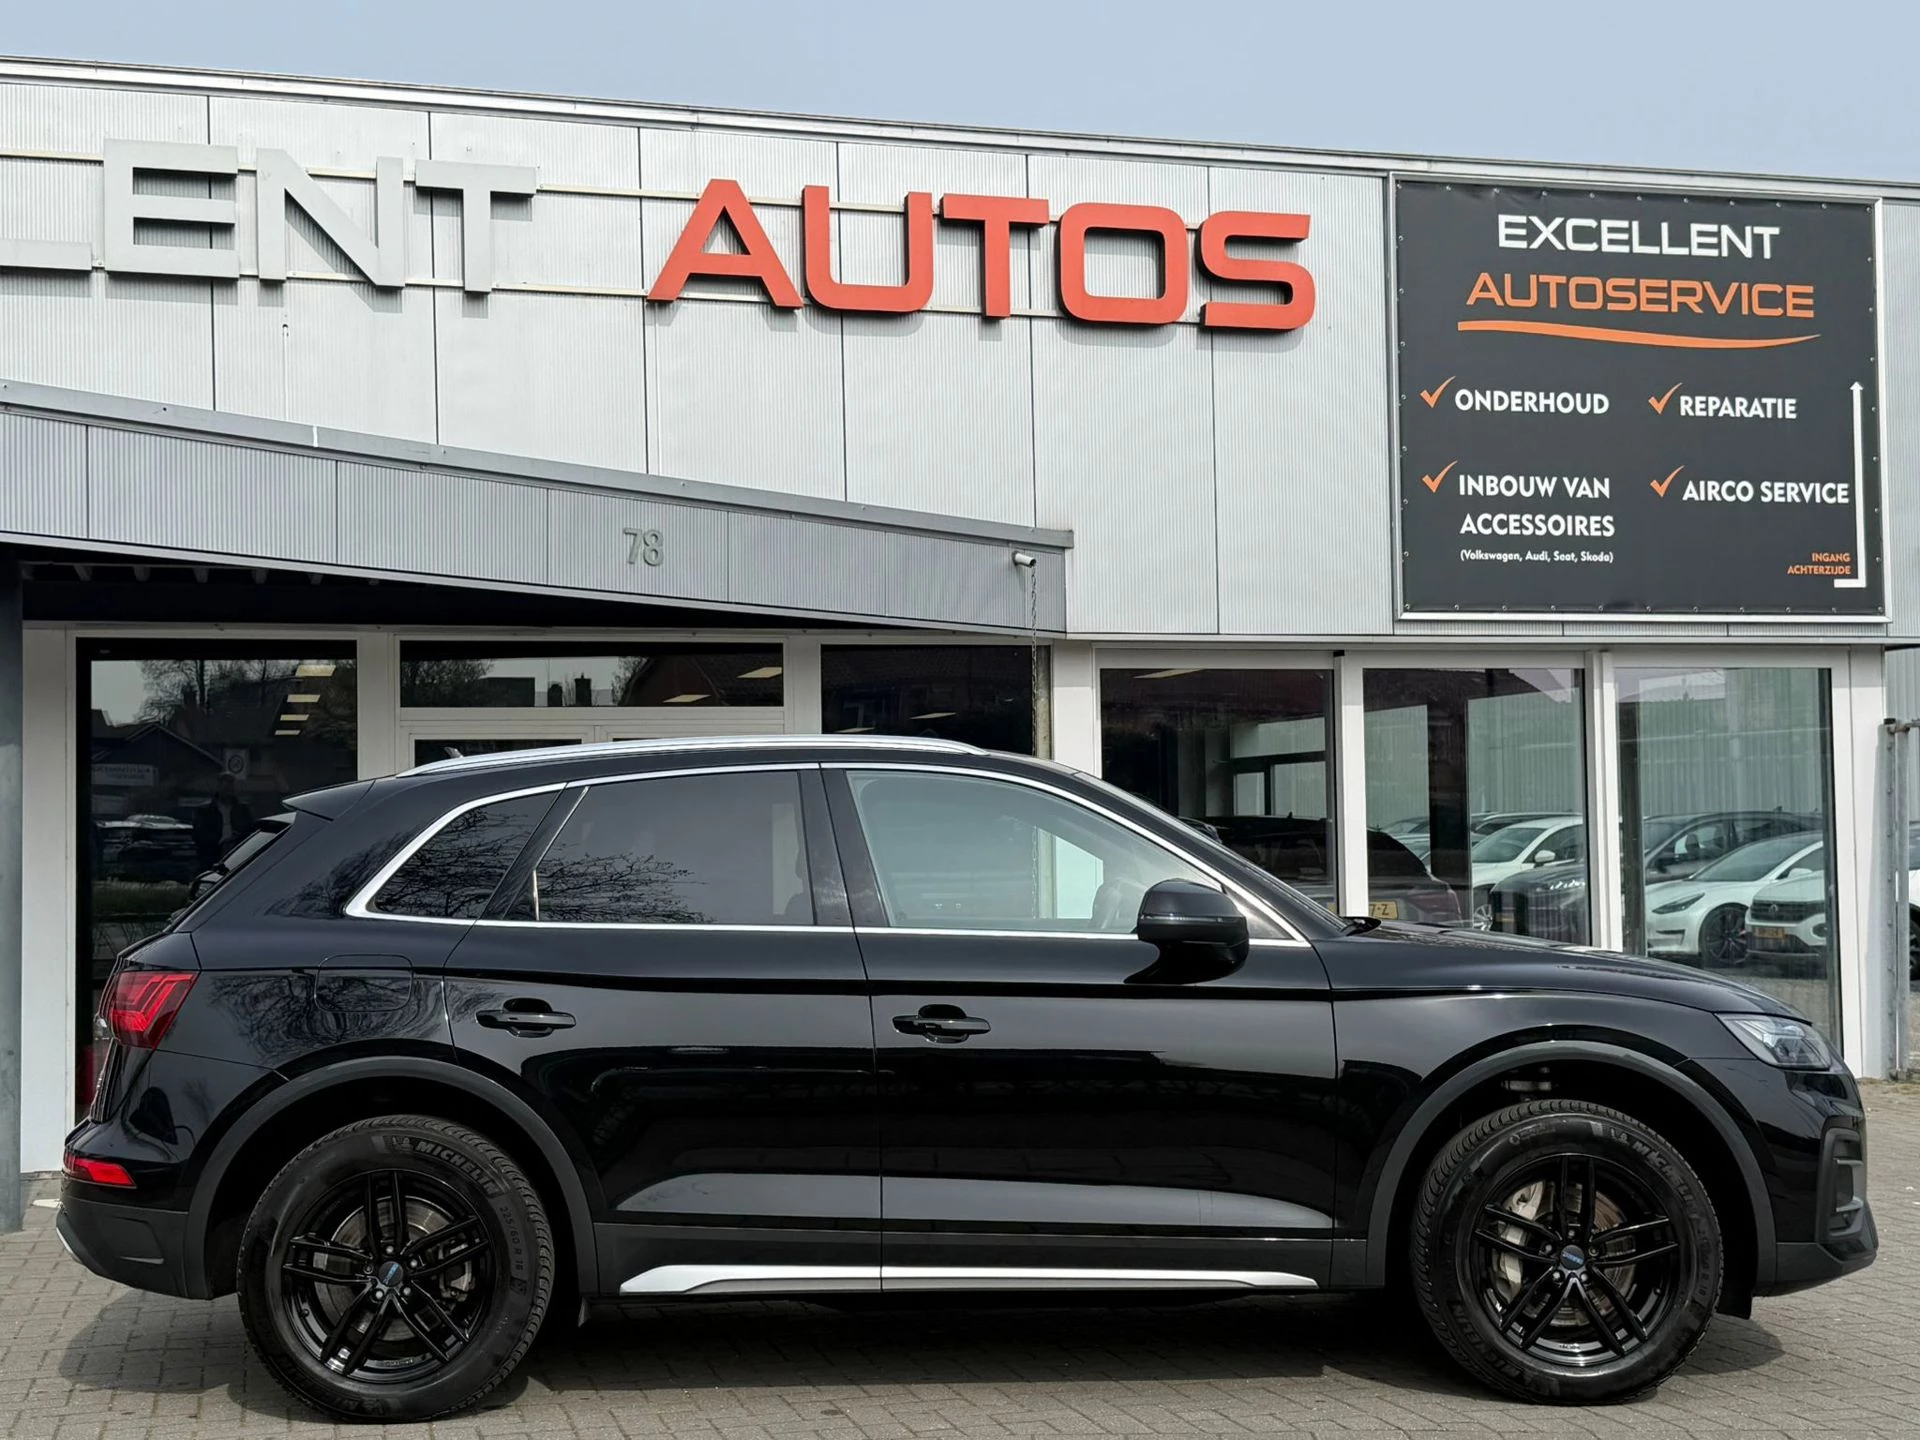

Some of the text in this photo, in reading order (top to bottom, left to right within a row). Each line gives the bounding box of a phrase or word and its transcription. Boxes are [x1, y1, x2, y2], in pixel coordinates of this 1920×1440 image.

[1497, 213, 1781, 260] EXCELLENT
[647, 178, 1316, 330] AUTOS
[1466, 271, 1816, 319] AUTOSERVICE
[1454, 388, 1610, 415] ONDERHOUD
[1679, 394, 1798, 420] REPARATIE
[1458, 474, 1611, 499] INBOUW VAN
[1681, 479, 1850, 504] AIRCO SERVICE
[1459, 512, 1616, 537] ACCESSOIRES
[623, 527, 664, 566] 78
[1460, 549, 1614, 564] (Volkswagen, Audi, Seat, Skoda)
[1811, 552, 1851, 562] INGANG
[1787, 565, 1852, 575] ACHTERZIJDE
[416, 1141, 499, 1195] MICHELIN
